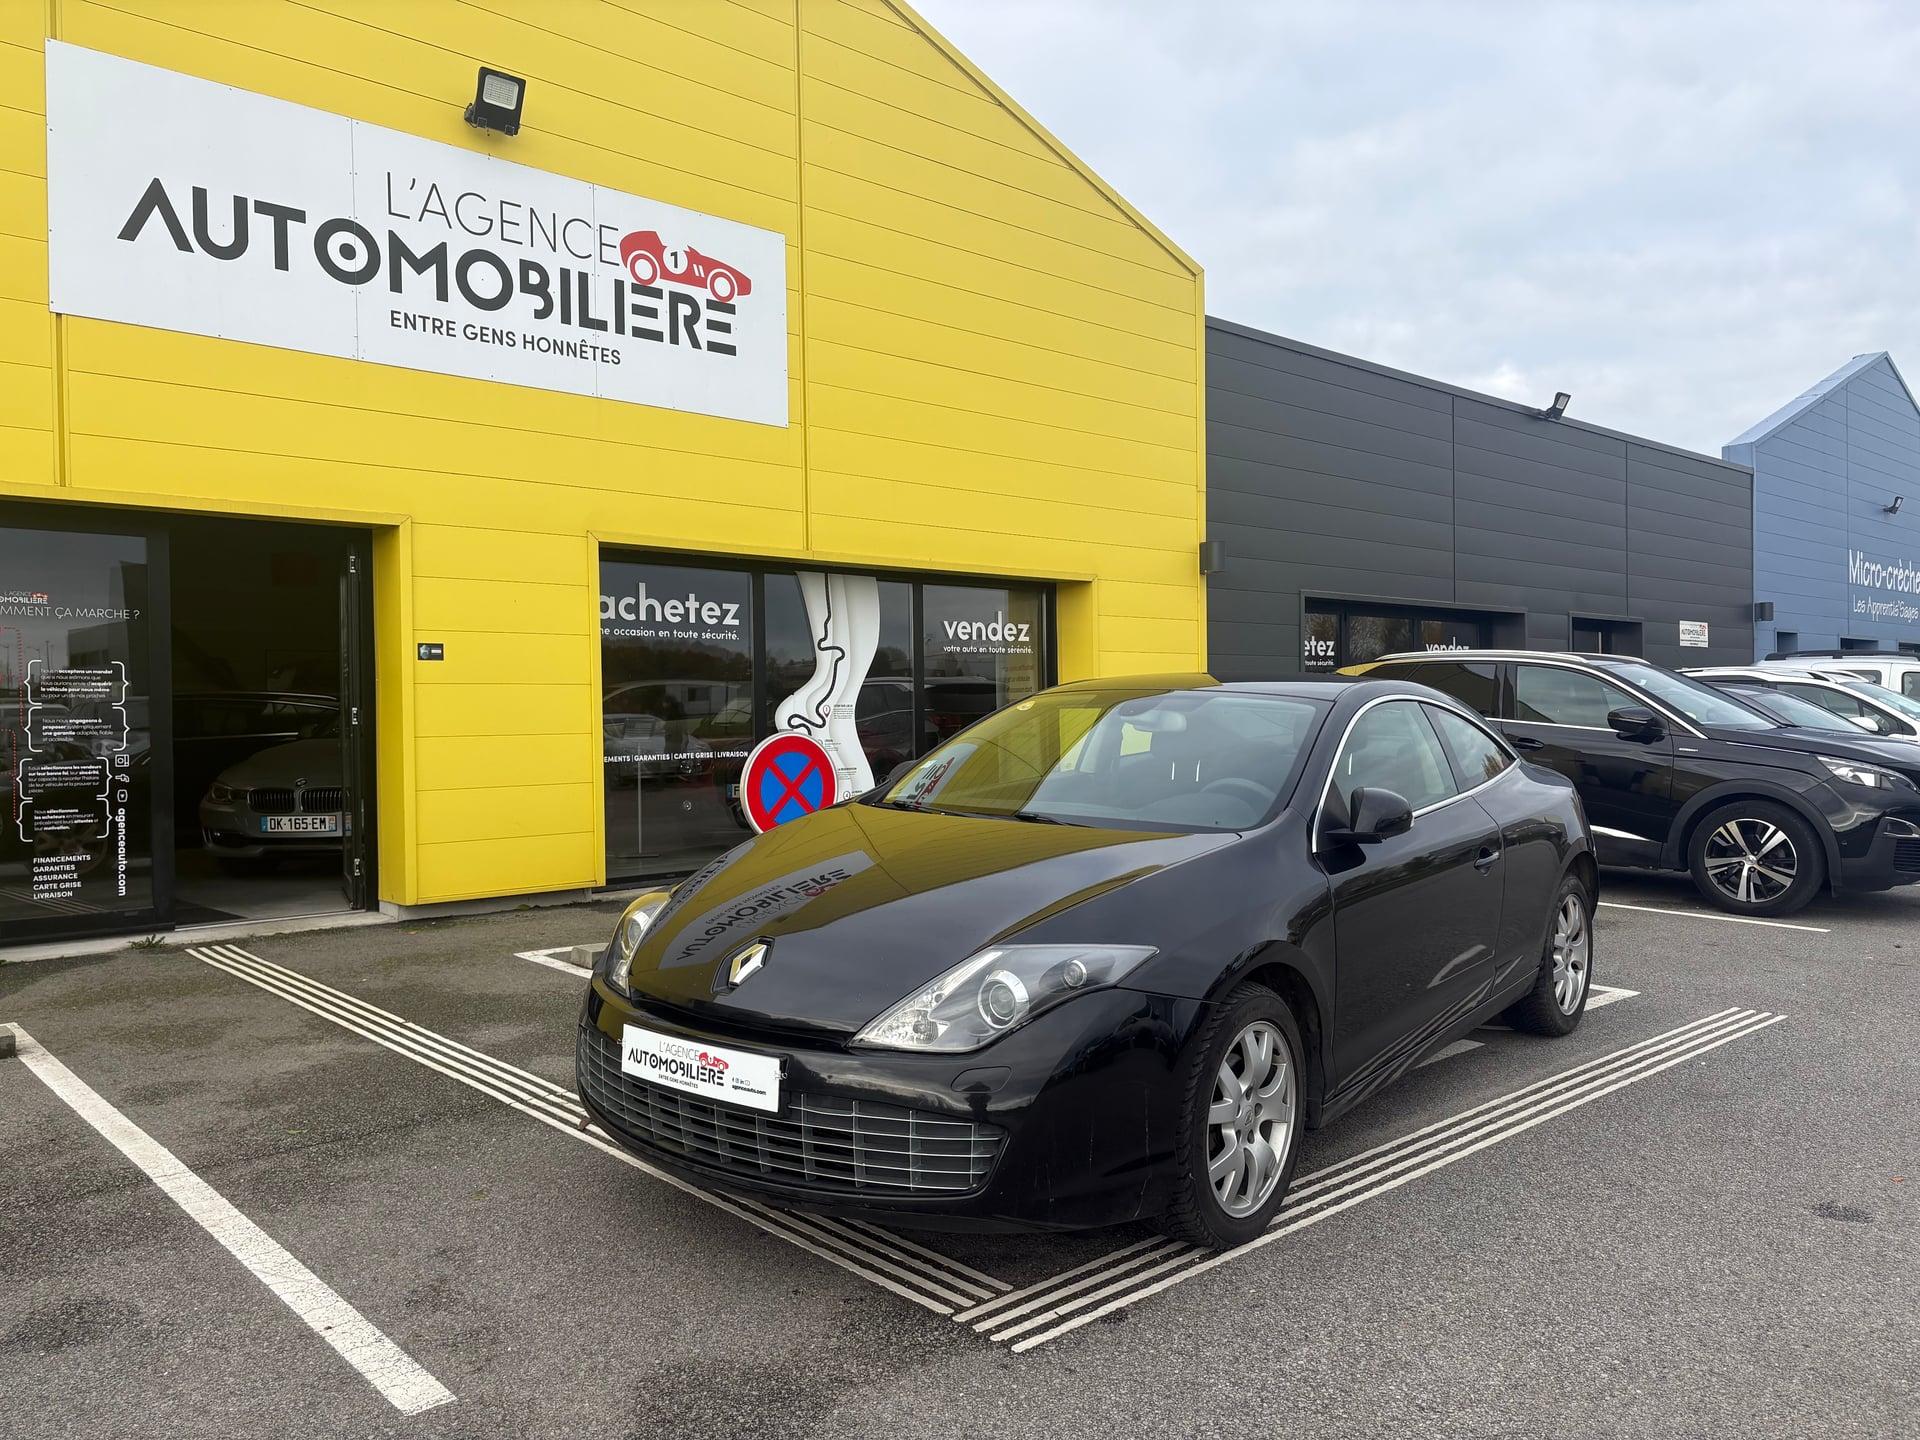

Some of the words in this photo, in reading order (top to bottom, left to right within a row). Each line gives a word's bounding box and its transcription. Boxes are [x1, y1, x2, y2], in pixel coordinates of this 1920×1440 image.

[387, 171, 620, 266] L'AGENCE
[670, 251, 679, 269] 1
[390, 311, 456, 339] ENTRE
[463, 325, 517, 348] GENS
[523, 335, 621, 365] HONNÊTES
[1849, 549, 1920, 594] Micro-crèche
[600, 582, 740, 625] achetez
[1853, 594, 1866, 613] Les
[55, 607, 72, 619] ÇA
[76, 608, 130, 619] MARCHE
[133, 609, 140, 619] ?
[943, 611, 1030, 641] vendez
[613, 627, 655, 637] occasion
[659, 630, 670, 638] en
[673, 629, 699, 639] toute
[702, 629, 740, 640] sécurité.
[962, 645, 977, 653] auto
[1007, 645, 1034, 654] sérénité.
[634, 754, 670, 762] GARANTIES
[673, 752, 694, 760] CARTE
[695, 751, 713, 759] GRISE
[269, 818, 327, 831] DK-165-EM
[115, 808, 128, 896] agenceauto.com
[33, 854, 91, 864] FINANCEMENTS
[33, 864, 76, 873] GARANTIES
[33, 873, 78, 882] ASSURANCE
[33, 882, 58, 891] CARTE
[59, 881, 82, 889] GRISE
[33, 890, 73, 900] LIVRAISON
[659, 1041, 700, 1061] L'AGENCE
